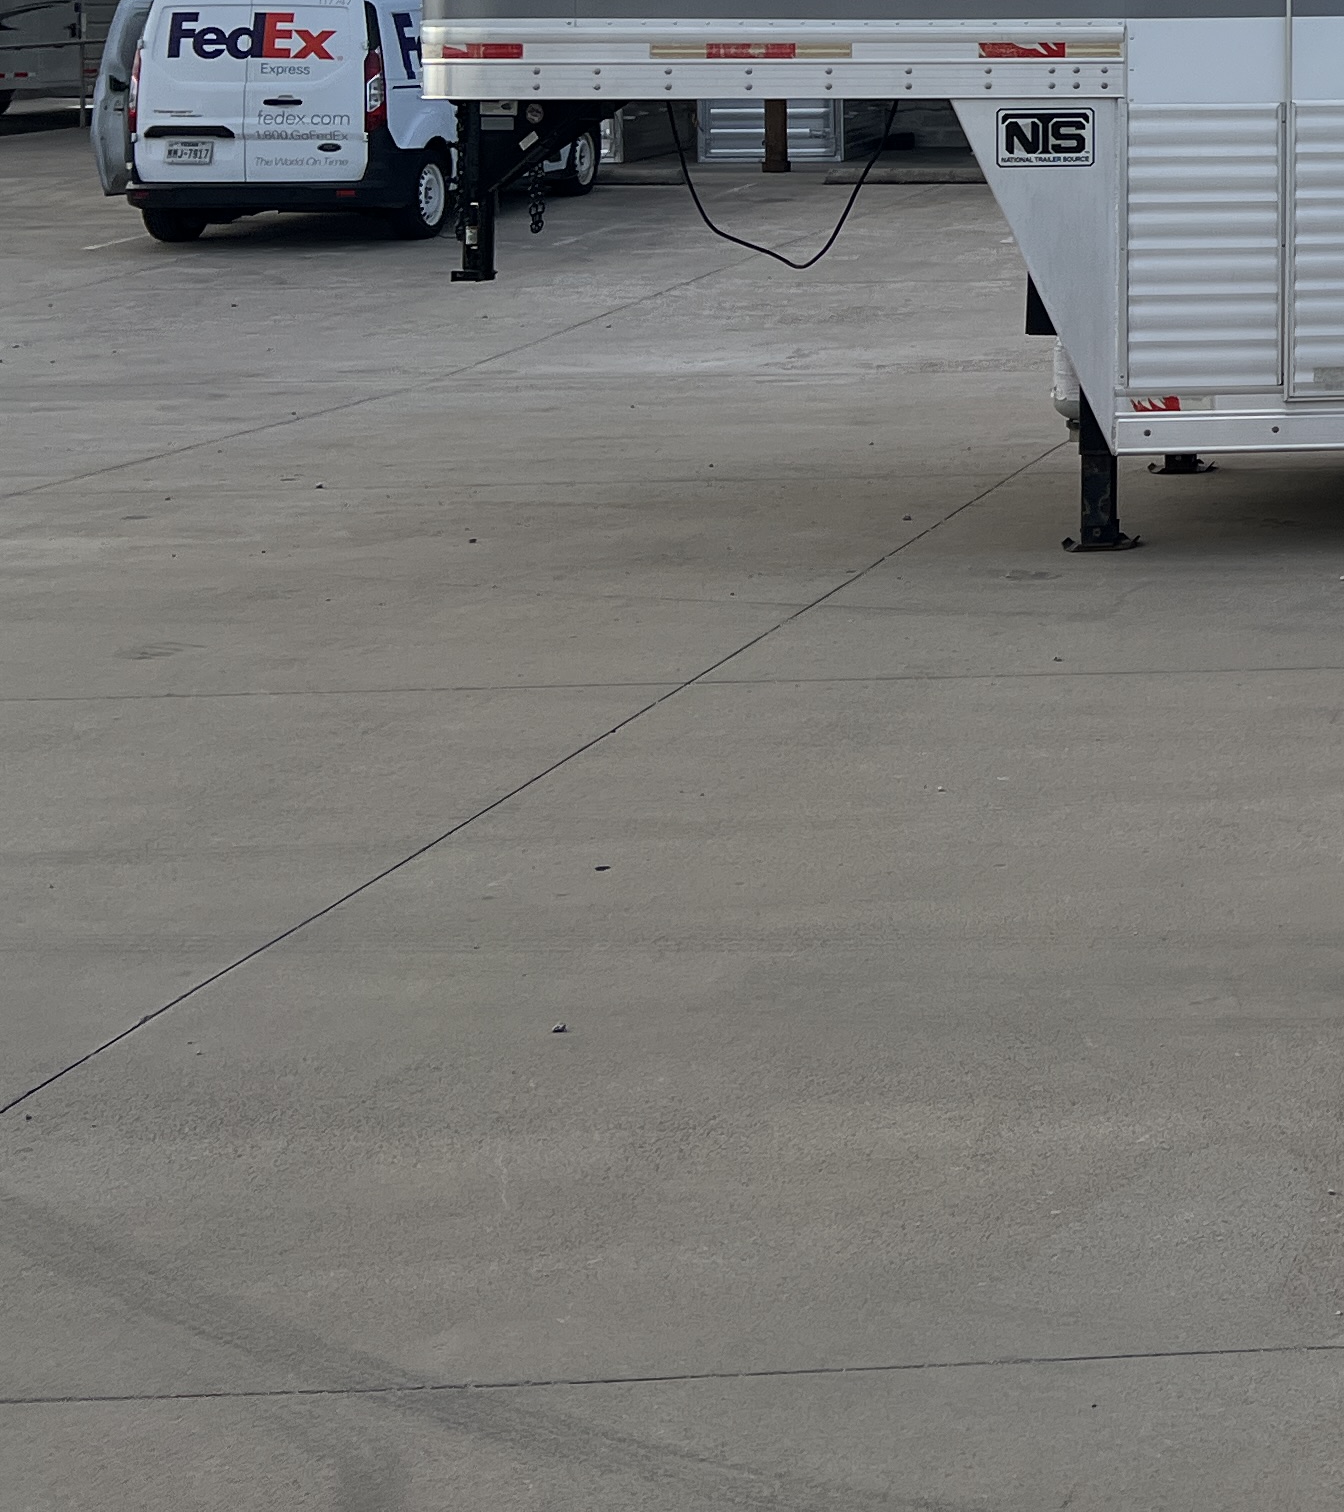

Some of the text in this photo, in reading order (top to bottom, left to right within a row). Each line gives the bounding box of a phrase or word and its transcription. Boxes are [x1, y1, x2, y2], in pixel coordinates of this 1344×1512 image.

[167, 11, 338, 61] FedEx
[260, 62, 311, 76] Express
[257, 109, 351, 126] fedex.com
[1001, 112, 1090, 155] NTS
[255, 156, 349, 167] The World On Time
[1001, 156, 1034, 164] NATIONAL
[1063, 155, 1090, 163] SOURCE
